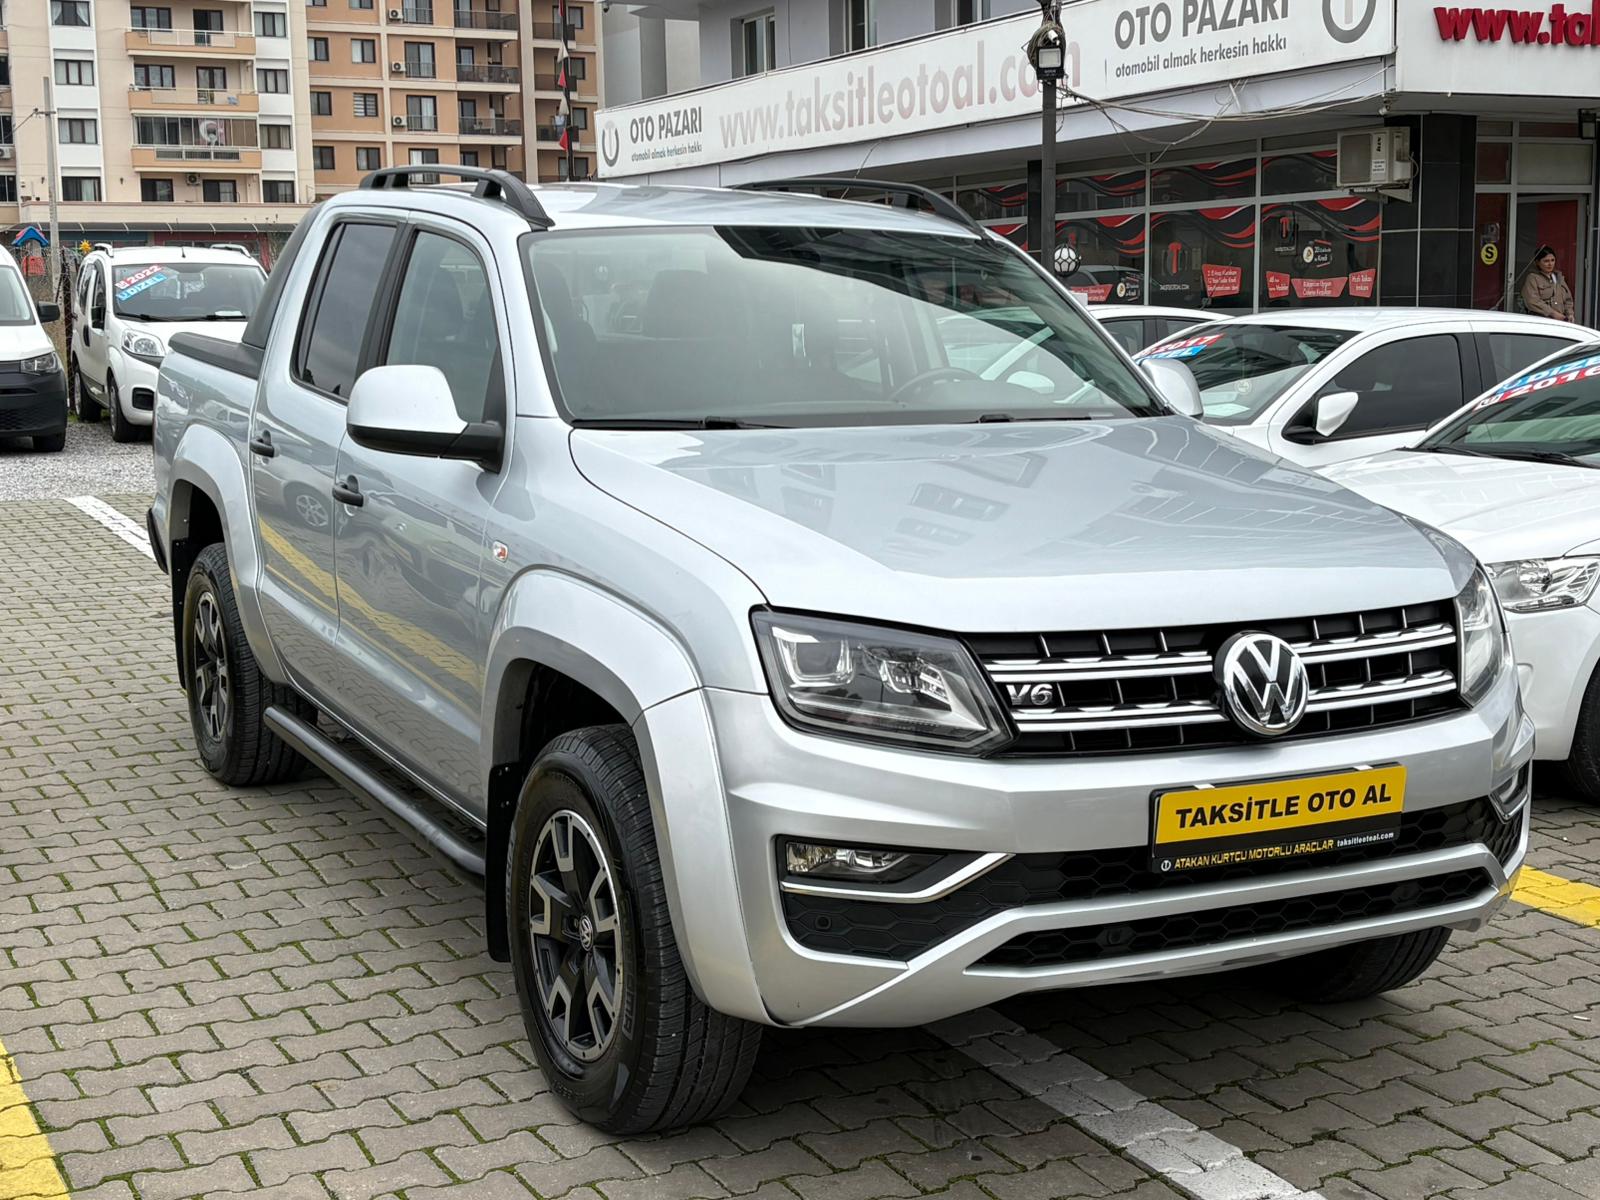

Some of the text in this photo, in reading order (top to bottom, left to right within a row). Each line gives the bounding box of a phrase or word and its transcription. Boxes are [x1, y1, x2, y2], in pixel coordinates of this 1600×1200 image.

[1114, 2, 1172, 49] OTO
[1434, 0, 1600, 46] www.ta
[1115, 33, 1287, 78] otomobil almak herkesin hakkı
[630, 106, 702, 144] OTO PAZARI
[126, 264, 162, 286] 2022
[1005, 683, 1053, 706] V6
[1175, 783, 1392, 829] TAKSİTLE OTO AL
[1174, 855, 1210, 870] ATAKAN
[1248, 843, 1292, 860] MOTORLU
[1293, 839, 1334, 855] ARAÇLAR
